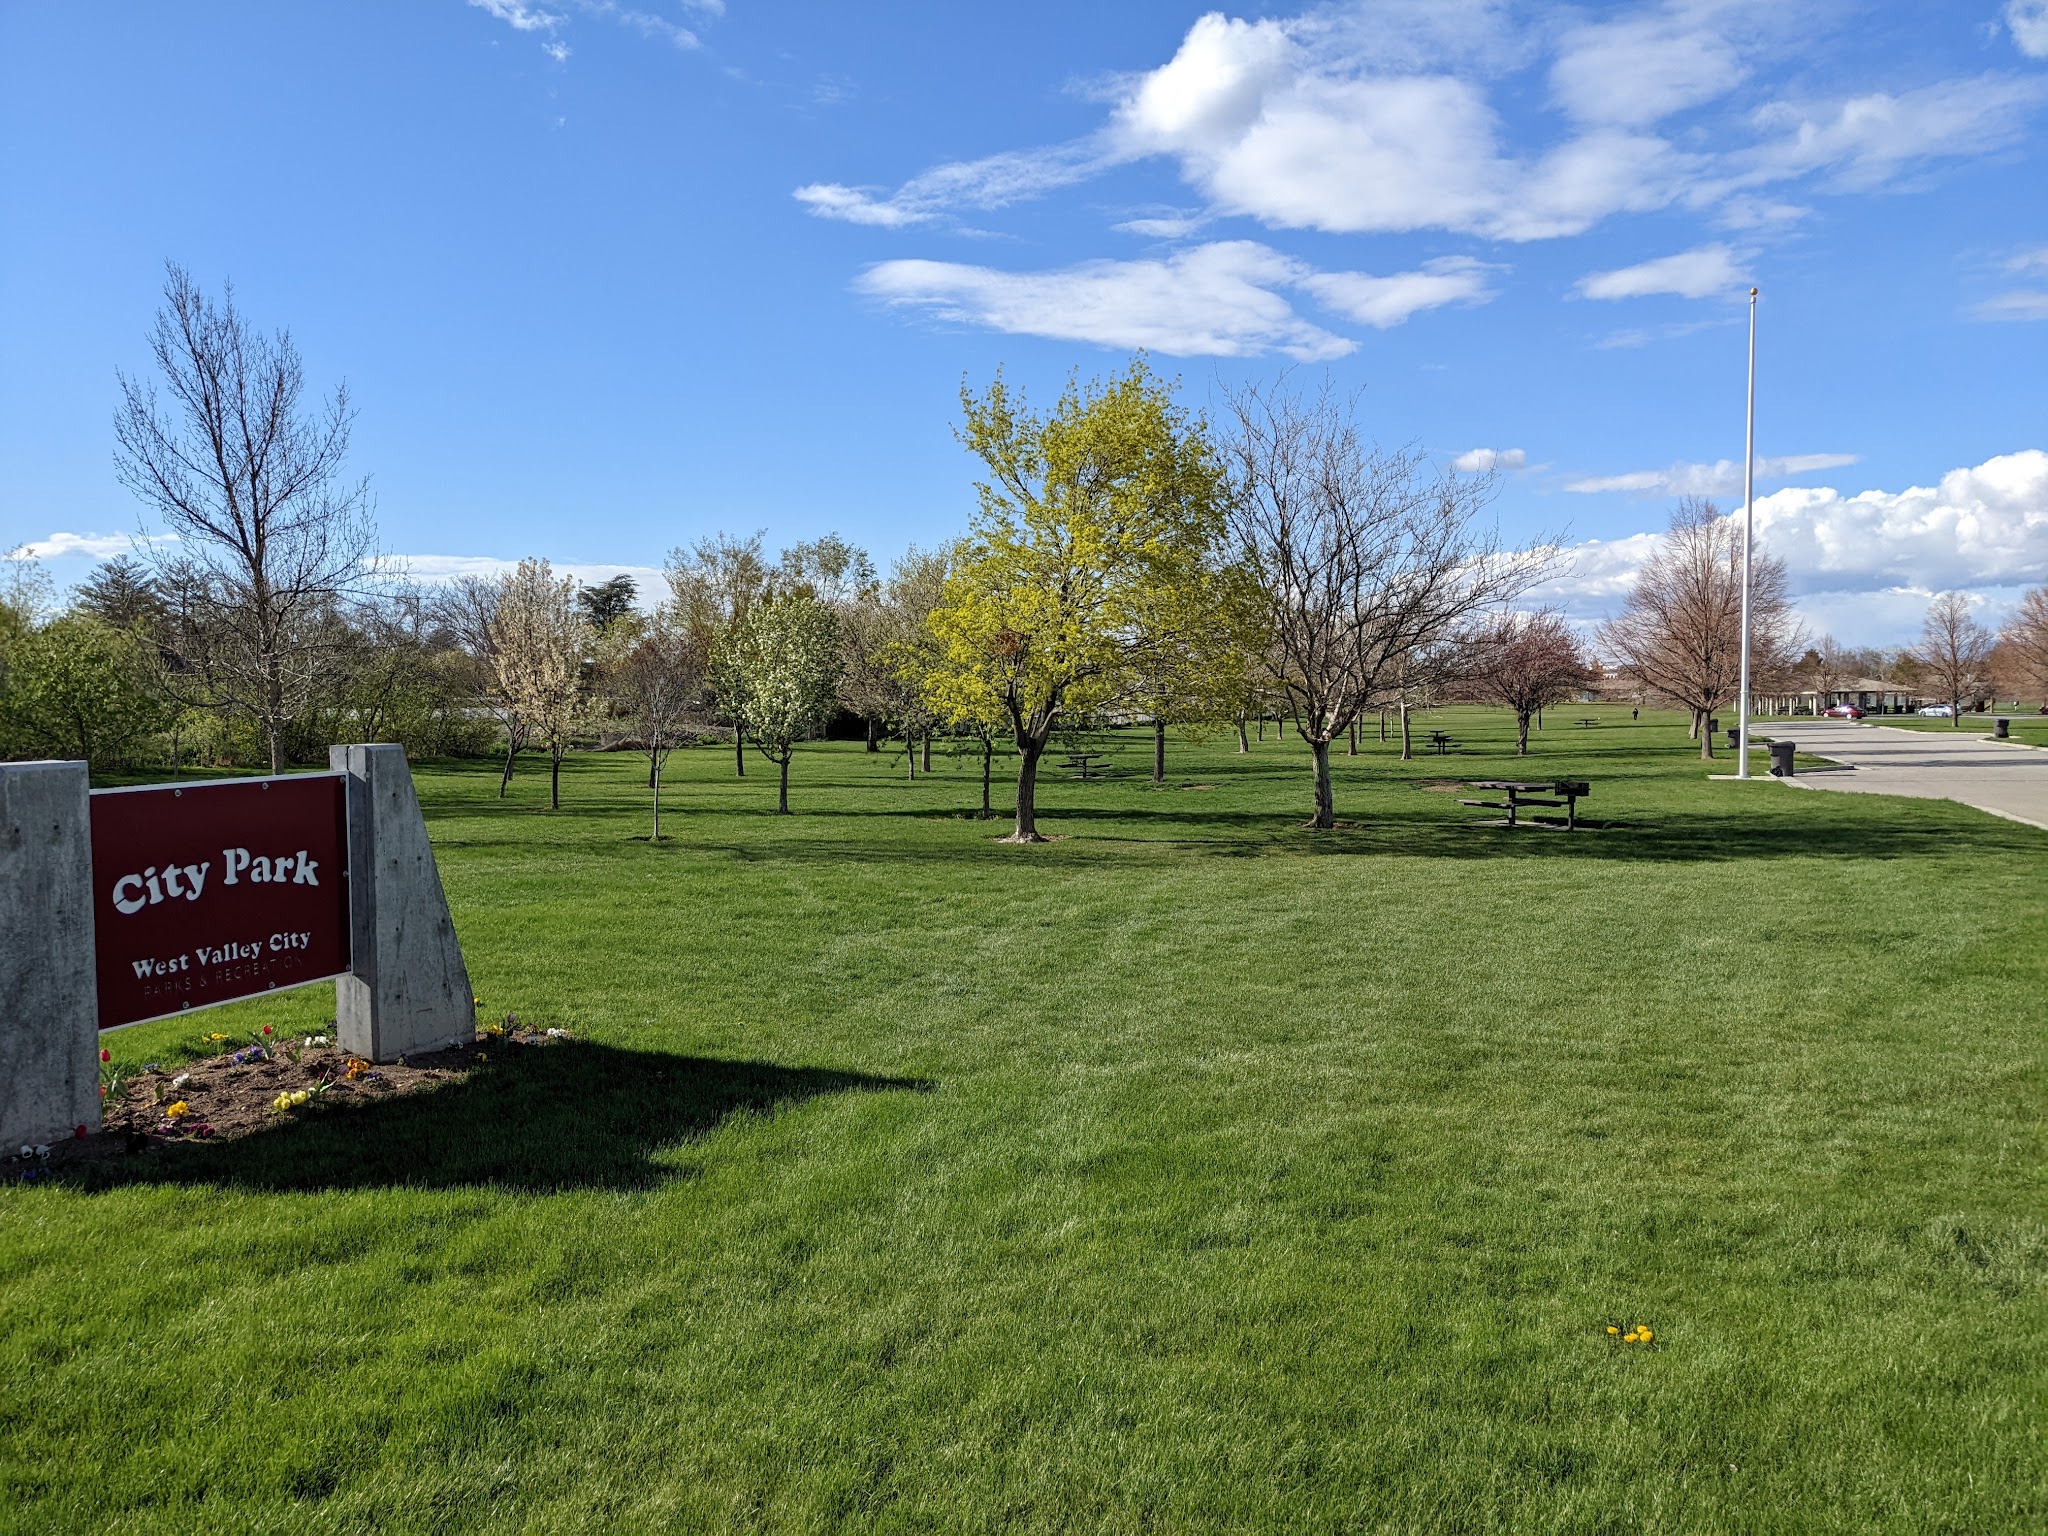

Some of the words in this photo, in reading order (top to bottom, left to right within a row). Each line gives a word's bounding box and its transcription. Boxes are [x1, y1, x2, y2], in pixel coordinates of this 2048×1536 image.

[112, 861, 211, 915] City
[222, 847, 320, 887] Park
[132, 953, 189, 980] West
[195, 941, 263, 967] Valley
[269, 931, 312, 952] City
[144, 977, 192, 999] PARKS
